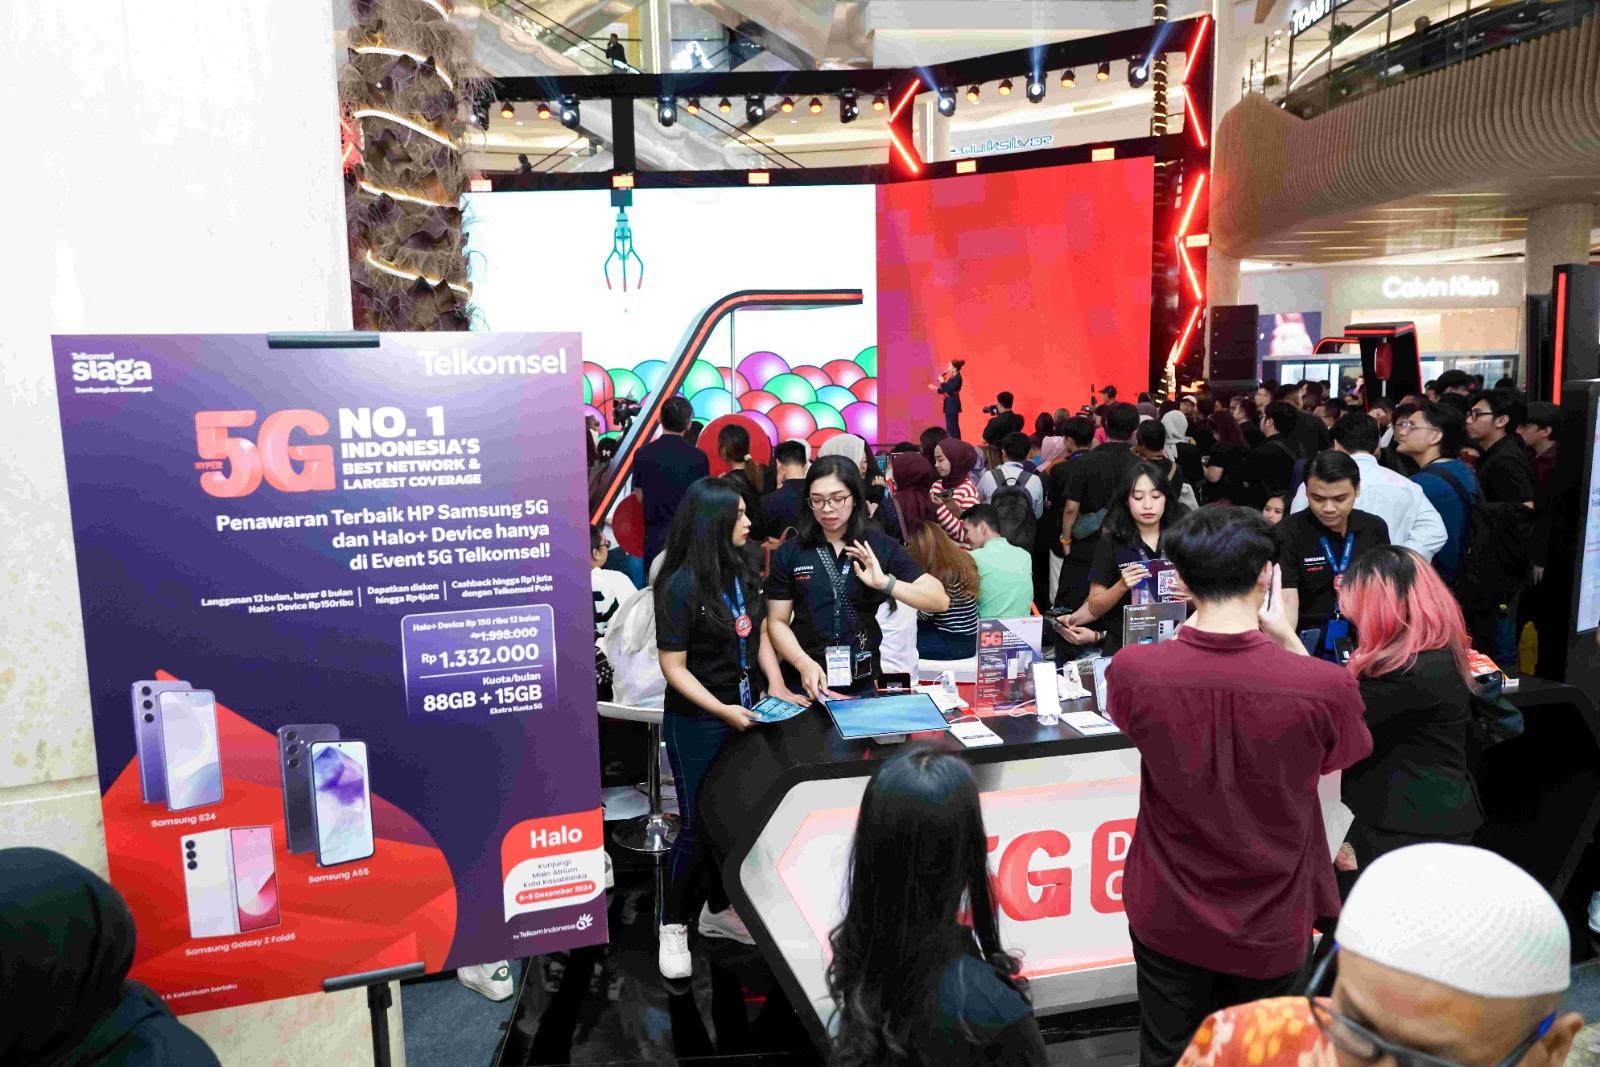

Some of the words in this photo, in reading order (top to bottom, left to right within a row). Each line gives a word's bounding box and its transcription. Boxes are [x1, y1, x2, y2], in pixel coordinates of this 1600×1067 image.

[1382, 276, 1447, 298] Calvin
[1450, 275, 1499, 297] Klein
[418, 348, 567, 376] Telkomsel
[72, 358, 152, 385] siaga
[338, 406, 416, 439] NO.
[426, 405, 445, 436] 1
[194, 408, 336, 498] 5G
[341, 438, 480, 459] INDONESIA'S
[342, 461, 384, 475] BEST
[386, 458, 465, 473] NETWORK
[469, 458, 481, 470] &
[344, 476, 406, 490] LARGEST
[409, 473, 481, 487] COVERAGE
[216, 513, 328, 532] Penawaran
[331, 506, 404, 525] Terbaik
[407, 504, 435, 521] HP
[438, 502, 522, 520] Samsung
[525, 499, 549, 515] 5G
[332, 531, 369, 548] dan
[373, 528, 428, 546] Halo+
[431, 525, 493, 542] Device
[496, 523, 550, 541] hanya
[350, 554, 368, 570] di
[371, 551, 425, 569] Event
[428, 549, 452, 566] 5G
[455, 542, 551, 564] Telkomsel!
[367, 584, 409, 595] Dapatkan
[410, 582, 439, 591] diskon
[452, 578, 491, 589] Cashback
[492, 577, 520, 587] hingga
[461, 588, 492, 598] dengan
[493, 586, 534, 596] Telkomsel
[535, 584, 553, 592] Poin
[201, 595, 252, 607] Langganan
[253, 594, 263, 603] 12
[264, 592, 293, 602] bulan,
[294, 590, 320, 600] bayar
[328, 588, 353, 597] bulan
[376, 594, 404, 605] hingga
[248, 605, 276, 614] Halo+
[277, 602, 307, 612] Device
[437, 621, 465, 630] Device
[466, 620, 477, 628] Rp
[477, 618, 491, 626] 150
[492, 617, 508, 625] ribu
[519, 614, 541, 623] bulan
[482, 672, 541, 685] Kuota/bulan
[423, 690, 476, 712] 88GB
[494, 684, 542, 704] 15GB
[490, 705, 512, 714] Ekstra
[513, 704, 533, 712] Kuota
[533, 702, 543, 710] 5G
[151, 815, 197, 828] Samsung
[199, 812, 216, 822] S24
[530, 825, 583, 849] Halo
[532, 869, 551, 879] Main
[552, 866, 578, 876] Atrium
[538, 859, 571, 869] Kunjungi
[308, 871, 350, 884] Samsung
[352, 867, 370, 878] A55
[523, 880, 541, 888] Kota
[542, 873, 587, 886] Kasablanka
[986, 829, 1072, 922] G
[534, 886, 574, 898] Desember
[520, 929, 543, 938] Telkom
[543, 923, 576, 933] Indonesia
[185, 942, 230, 957] Samsung
[231, 938, 262, 951] Galaxy
[173, 987, 210, 999] Ketentuan
